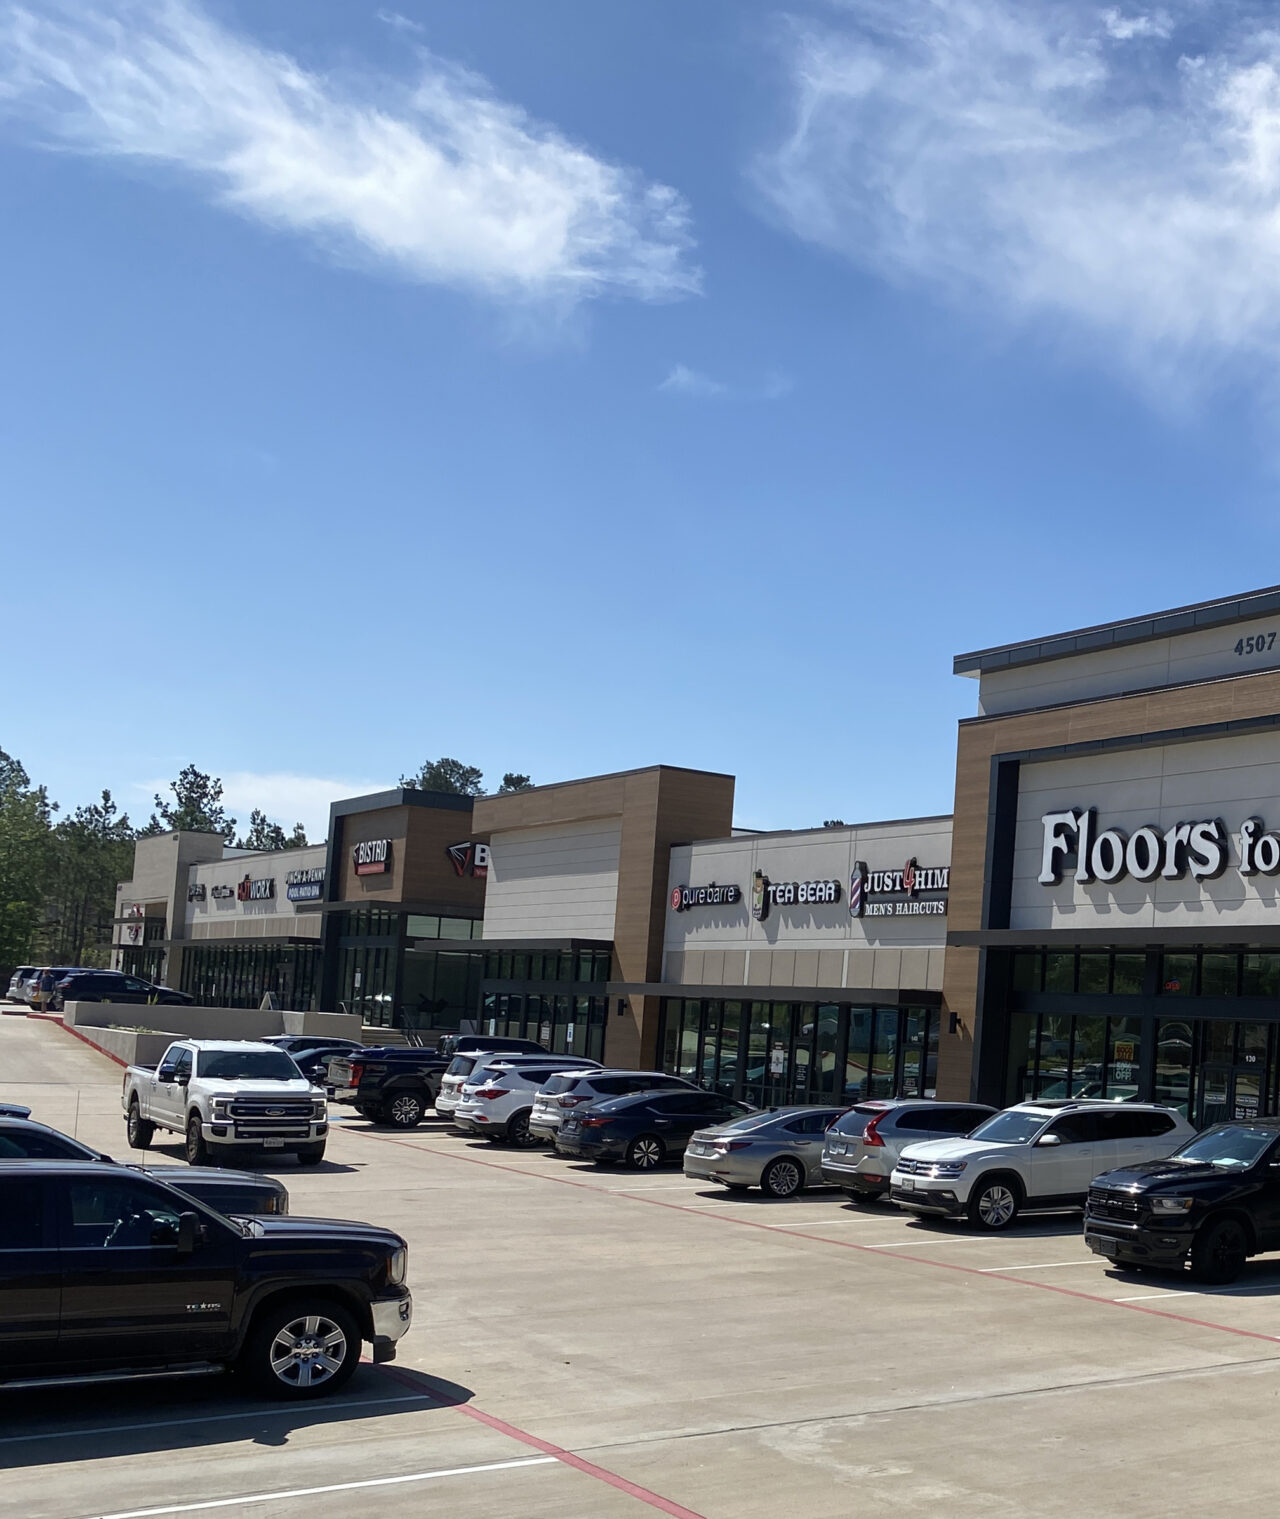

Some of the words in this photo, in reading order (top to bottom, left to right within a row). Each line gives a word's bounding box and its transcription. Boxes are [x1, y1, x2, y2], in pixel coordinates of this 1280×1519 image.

[1234, 632, 1277, 656] 4507
[358, 839, 388, 864] BISTRO
[1038, 808, 1221, 884] Floors
[285, 869, 325, 885] INCH-A-PENNY
[768, 884, 794, 903] TEA
[798, 883, 835, 902] BEAR
[865, 903, 893, 915] MEN'S
[896, 901, 945, 915] HAIRCUTS
